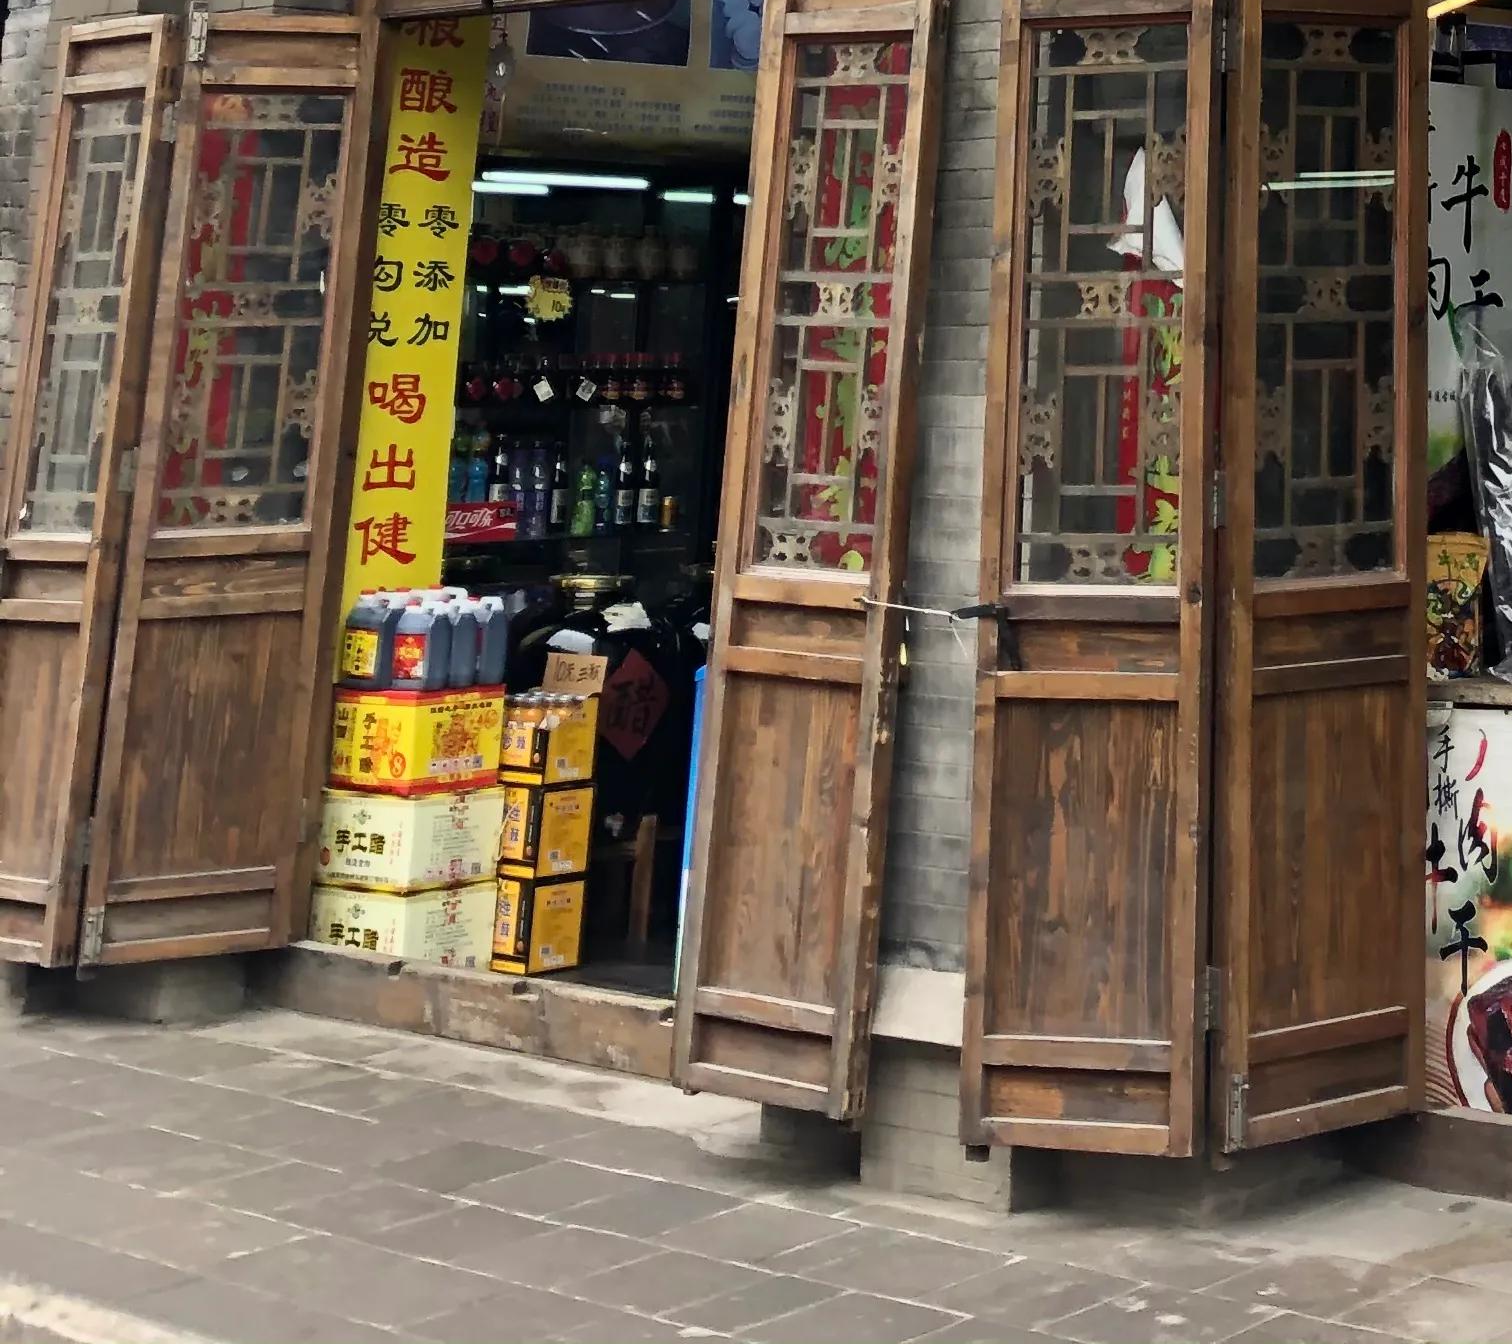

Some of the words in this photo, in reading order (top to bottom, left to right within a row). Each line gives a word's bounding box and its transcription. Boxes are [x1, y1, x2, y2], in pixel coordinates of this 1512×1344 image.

[407, 204, 459, 346] 零添加
[354, 373, 427, 592] 喝出健
[335, 829, 386, 855] 手工醋
